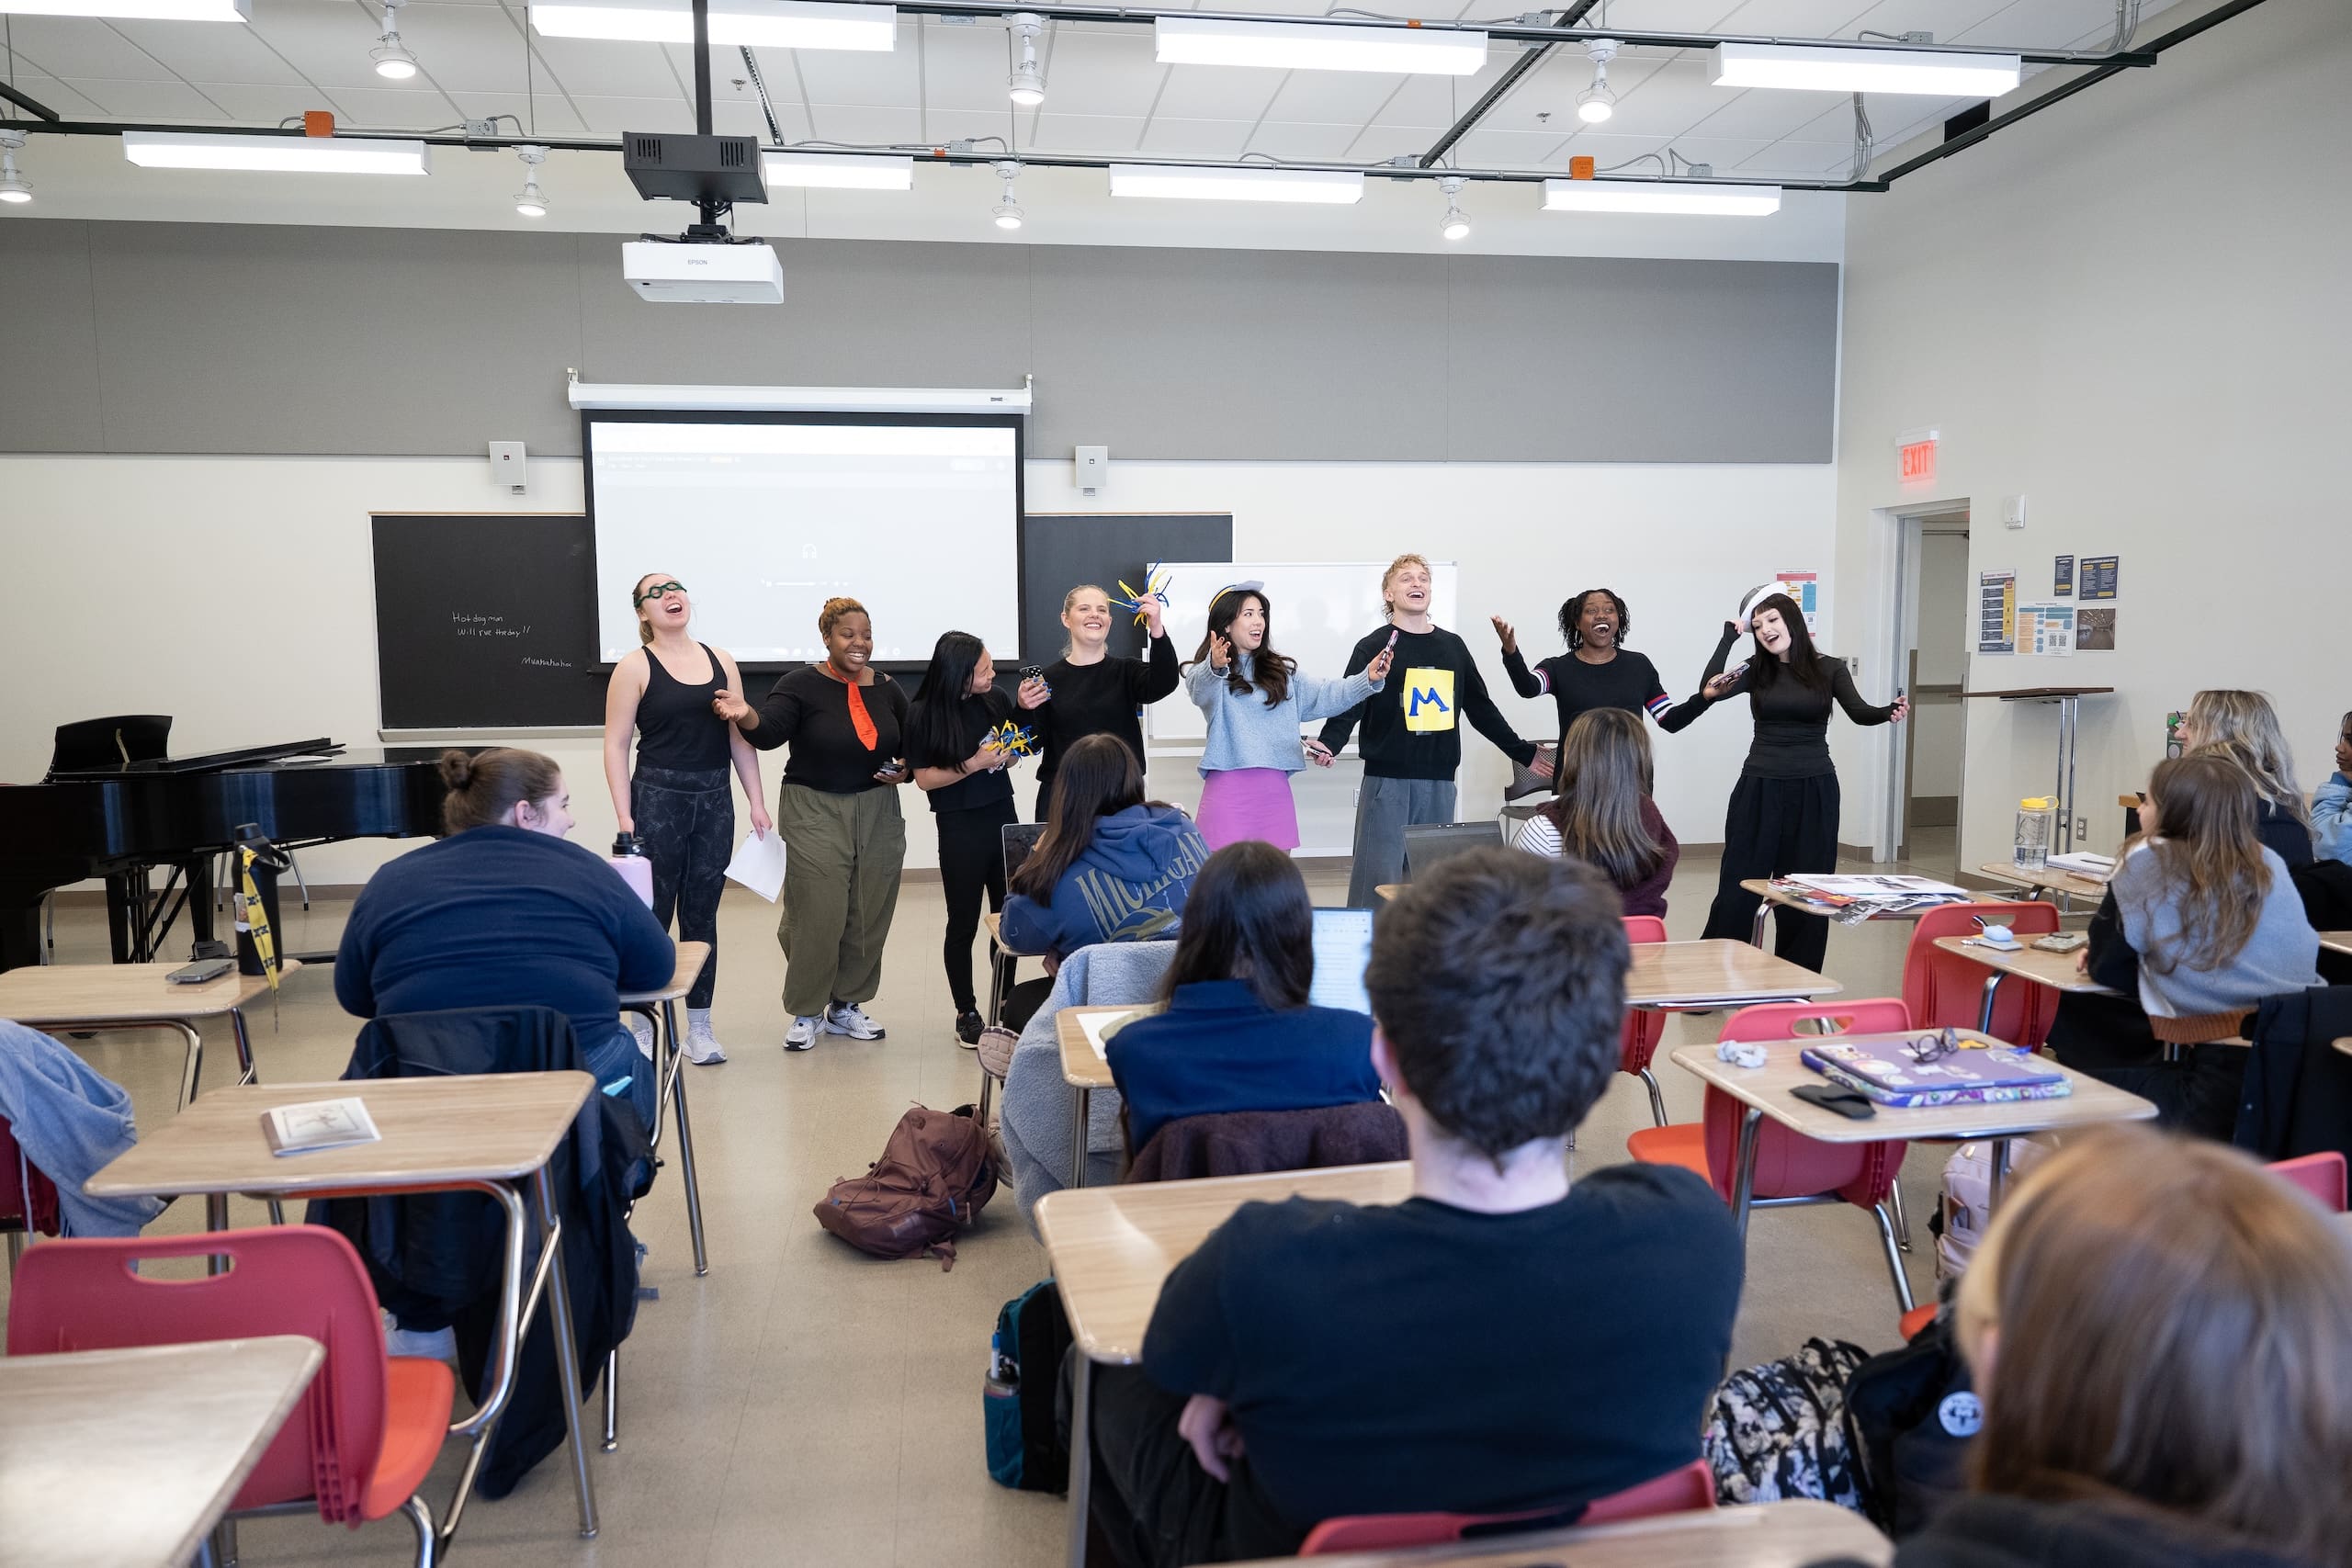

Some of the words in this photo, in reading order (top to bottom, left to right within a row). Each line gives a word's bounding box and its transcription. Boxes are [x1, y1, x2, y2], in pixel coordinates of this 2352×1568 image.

[1903, 445, 1929, 477] EXIT
[452, 611, 471, 623] Hot
[472, 613, 486, 626] dog
[1408, 686, 1450, 716] M
[1075, 830, 1210, 942] MICAN
